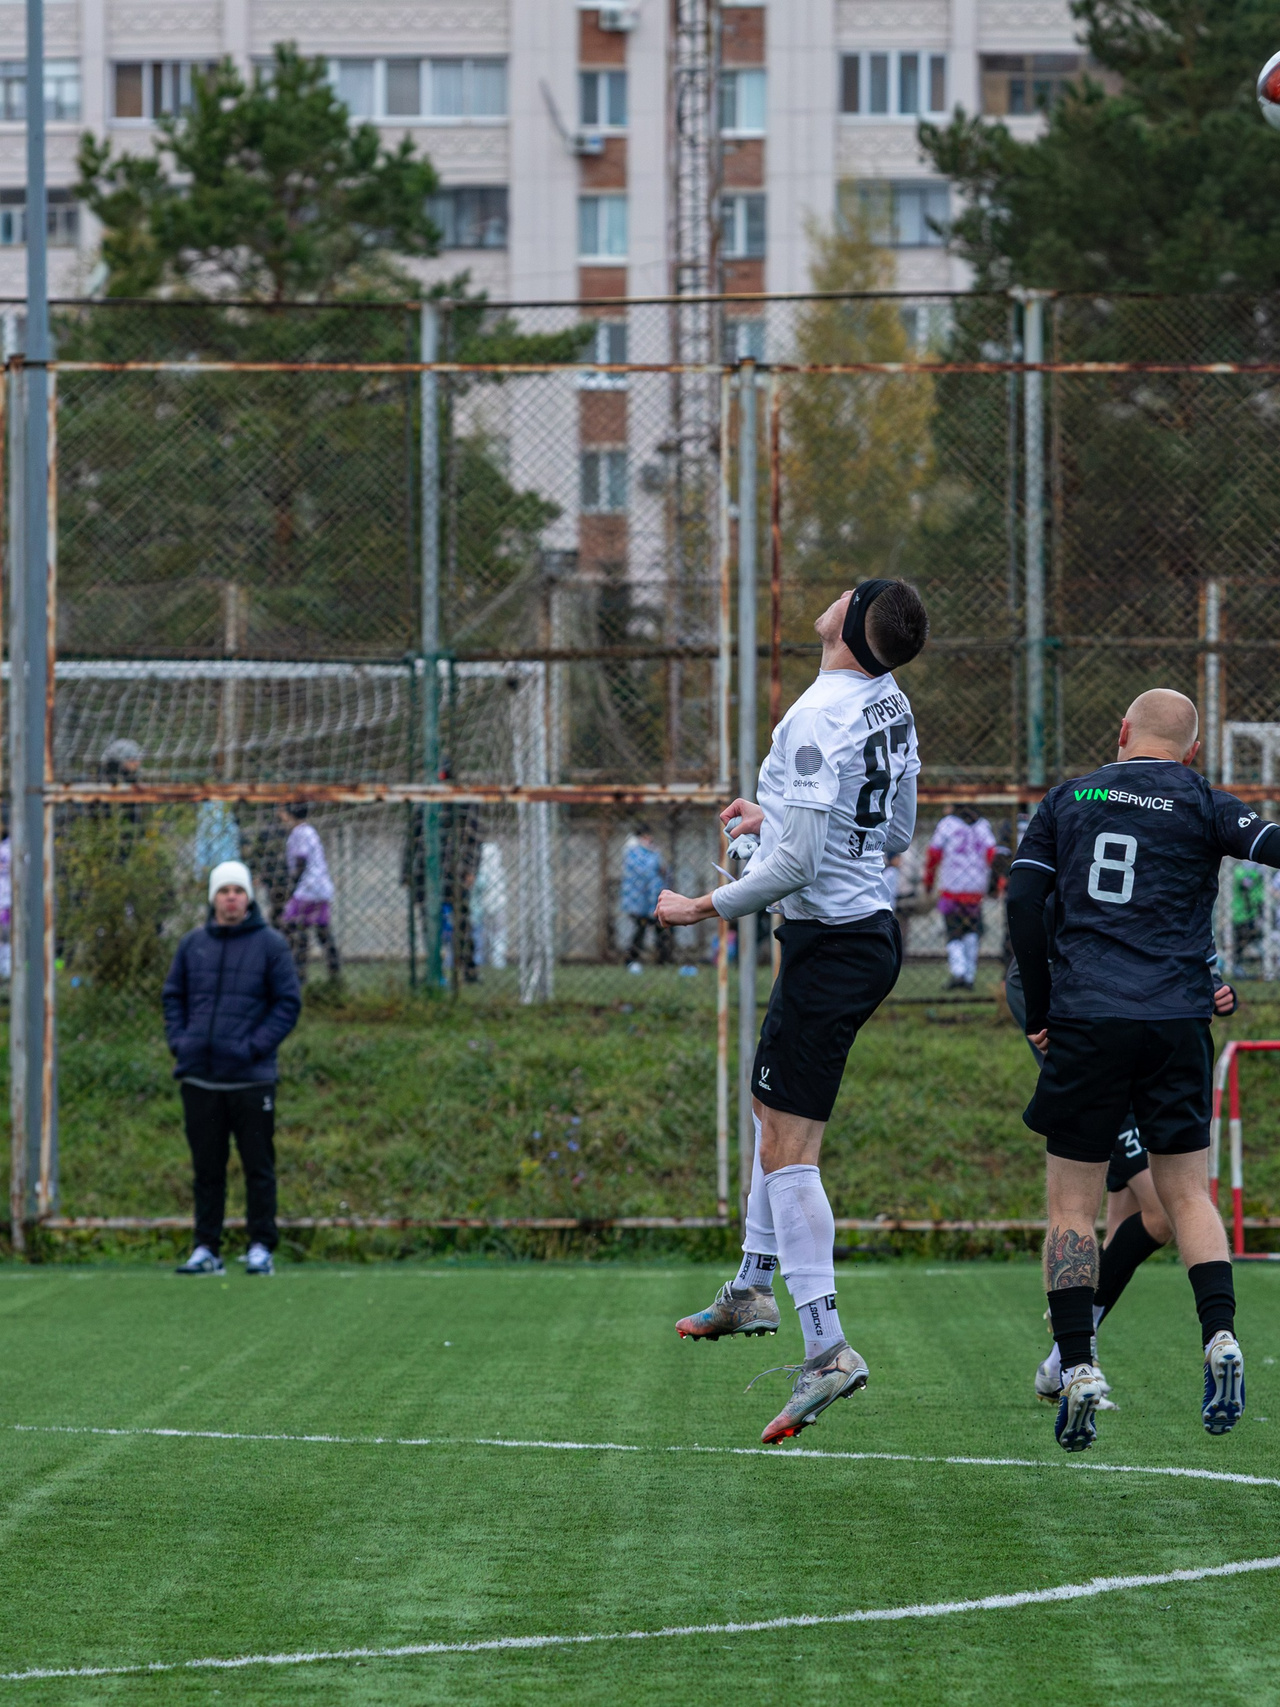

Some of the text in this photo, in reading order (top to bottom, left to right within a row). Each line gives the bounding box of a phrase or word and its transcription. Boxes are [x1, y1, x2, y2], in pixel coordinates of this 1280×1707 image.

[793, 779, 820, 790] ФЕНИКС
[854, 724, 910, 829] 87
[1074, 788, 1174, 812] VINSERVICE
[1087, 832, 1138, 904] 8
